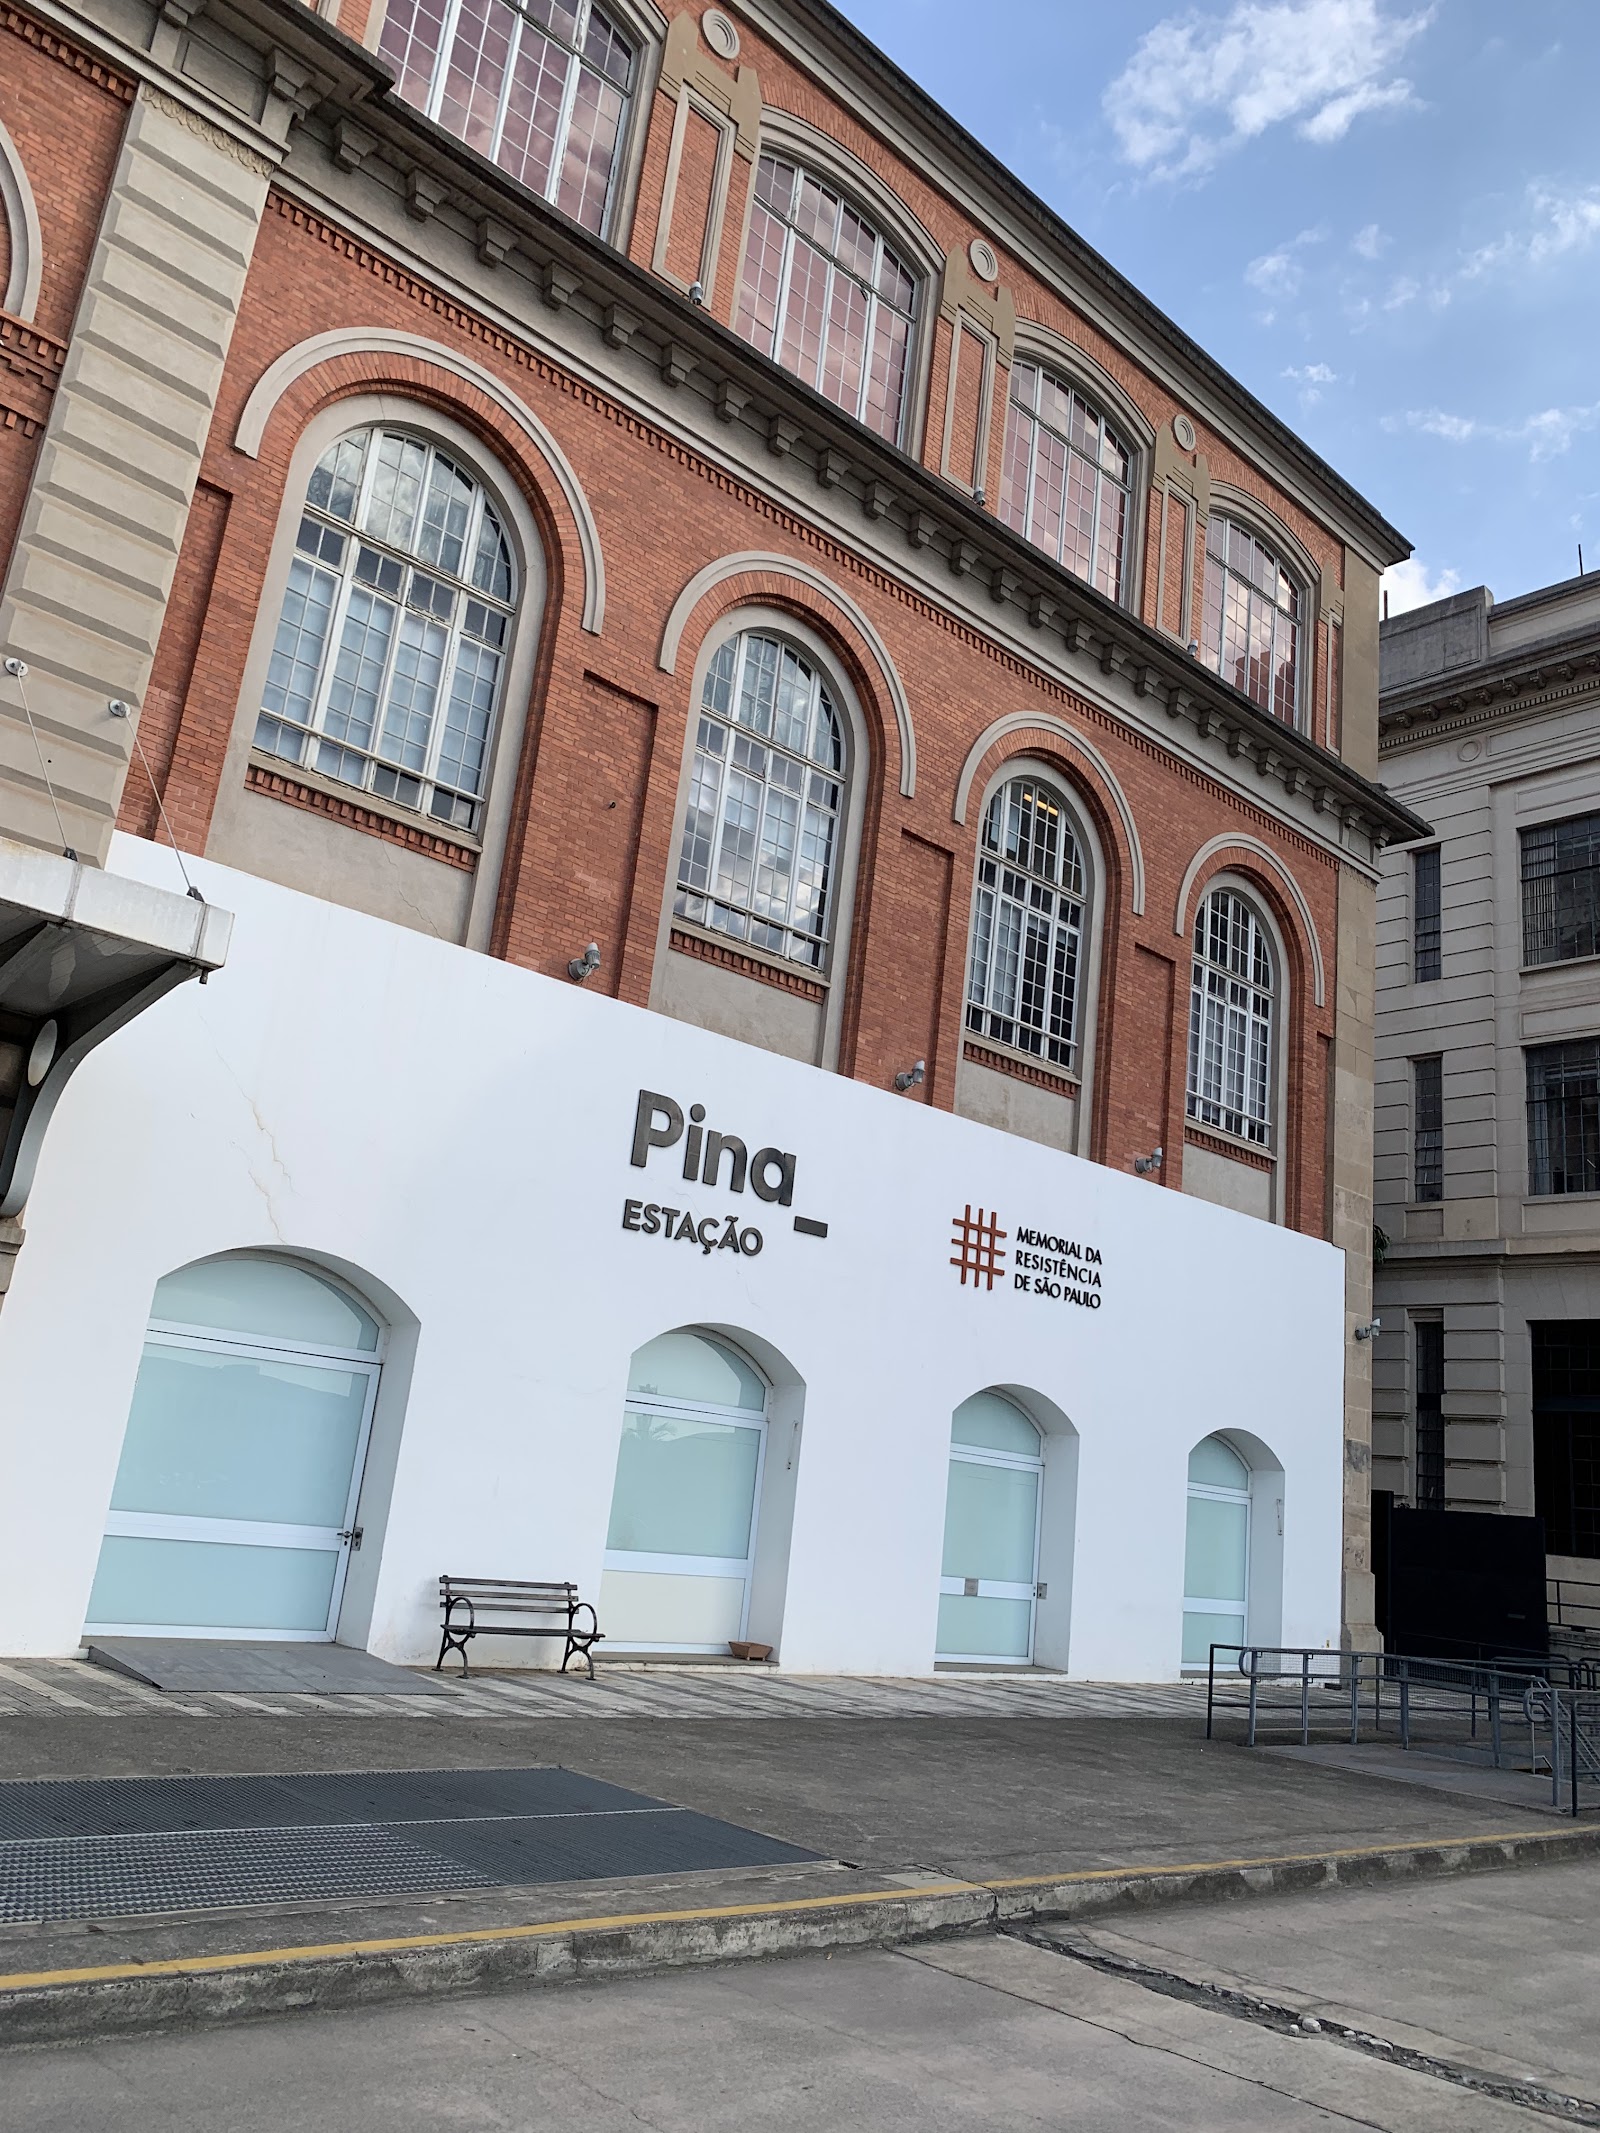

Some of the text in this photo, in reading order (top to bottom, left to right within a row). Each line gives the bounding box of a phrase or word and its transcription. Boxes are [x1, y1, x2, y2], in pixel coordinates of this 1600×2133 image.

[621, 1198, 764, 1257] ESTAÇÃO
[1016, 1226, 1103, 1265] MEMORIAL DA
[1015, 1249, 1102, 1288] RESISTÊNCIA
[1014, 1273, 1102, 1309] DE SÃO PAULO
